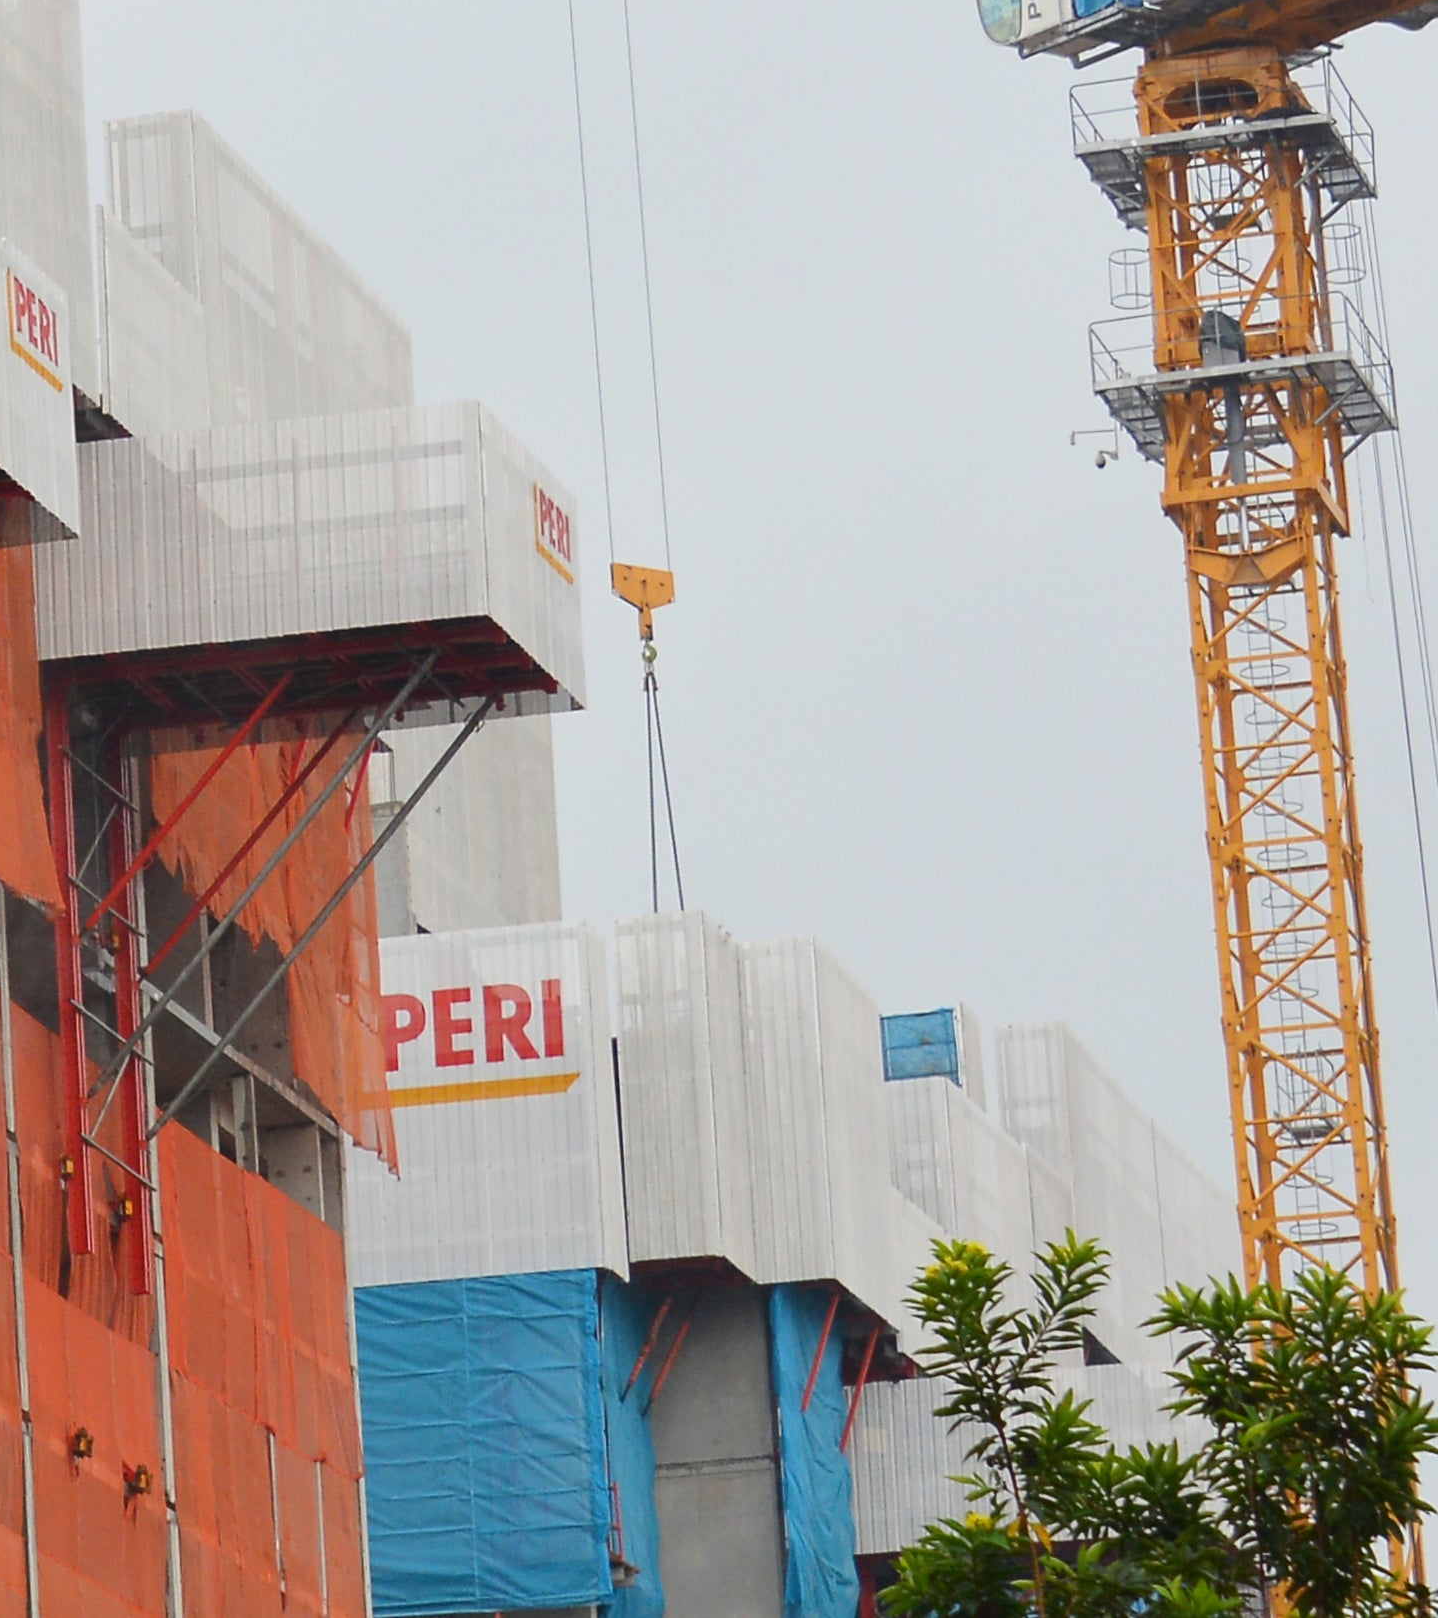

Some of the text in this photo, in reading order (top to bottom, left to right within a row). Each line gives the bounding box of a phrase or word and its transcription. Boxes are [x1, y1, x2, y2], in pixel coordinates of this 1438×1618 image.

[13, 275, 59, 368] PERI
[539, 488, 571, 563] PERI
[380, 979, 564, 1072] PERI
